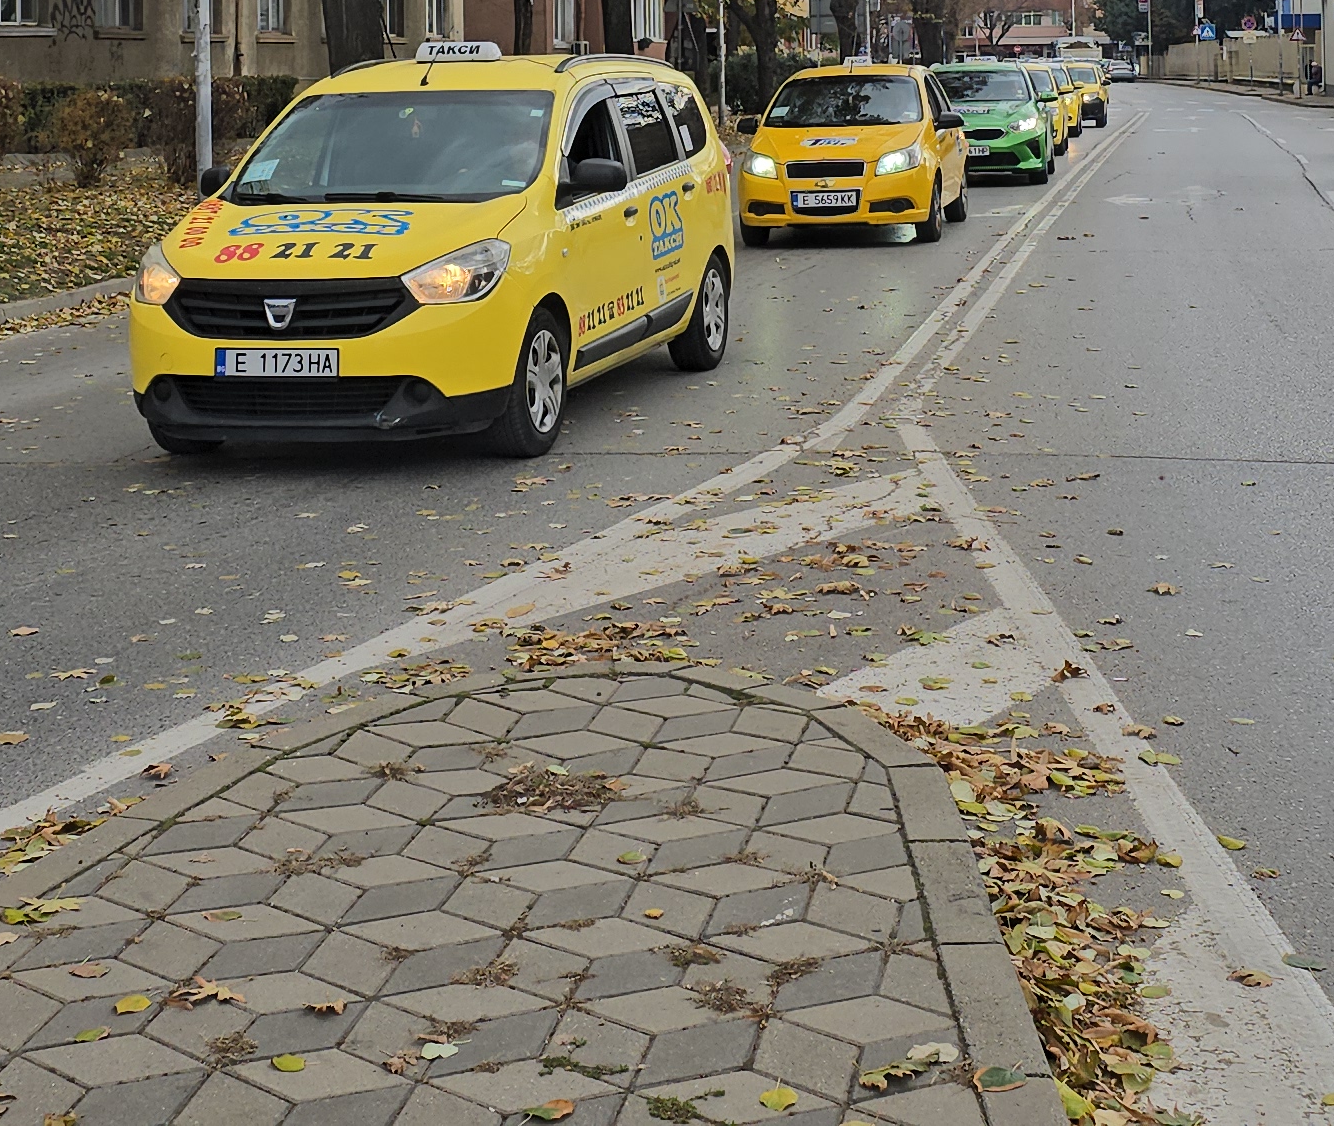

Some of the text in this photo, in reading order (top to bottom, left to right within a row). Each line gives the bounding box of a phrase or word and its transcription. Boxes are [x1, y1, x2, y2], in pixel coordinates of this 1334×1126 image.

[428, 45, 481, 55] ТАКСИ
[802, 196, 809, 205] E
[649, 191, 682, 237] OK
[214, 242, 379, 263] 88 21 21
[235, 352, 247, 372] E
